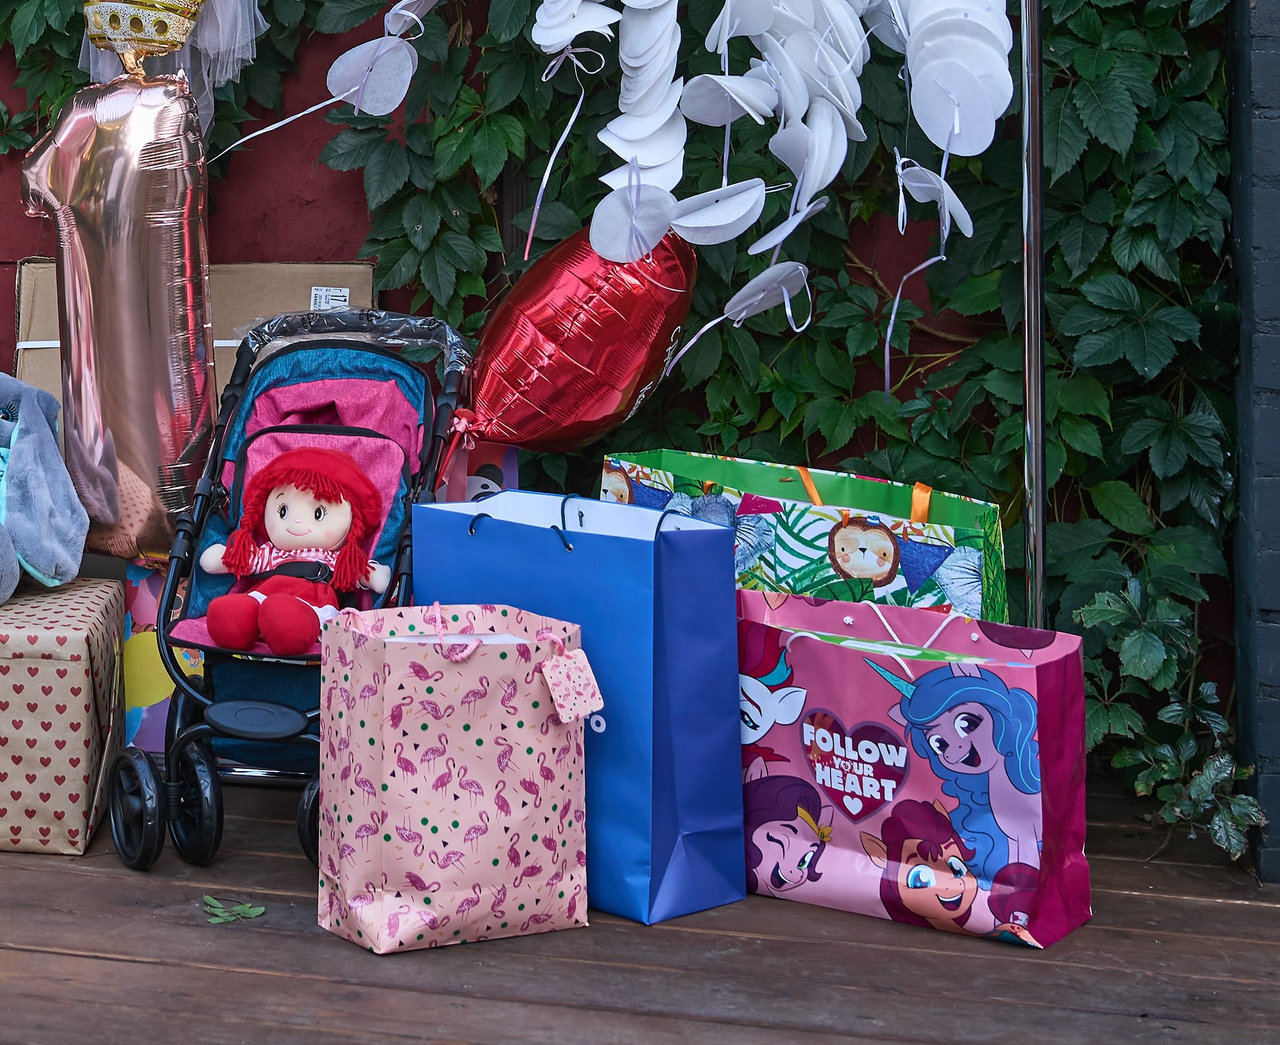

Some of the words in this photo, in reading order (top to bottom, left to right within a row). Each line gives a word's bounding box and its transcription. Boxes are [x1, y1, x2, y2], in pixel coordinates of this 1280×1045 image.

[21, 72, 210, 561] 1
[803, 722, 908, 767] FOLLOW
[815, 763, 896, 801] HEART
[832, 756, 874, 777] YOUR
